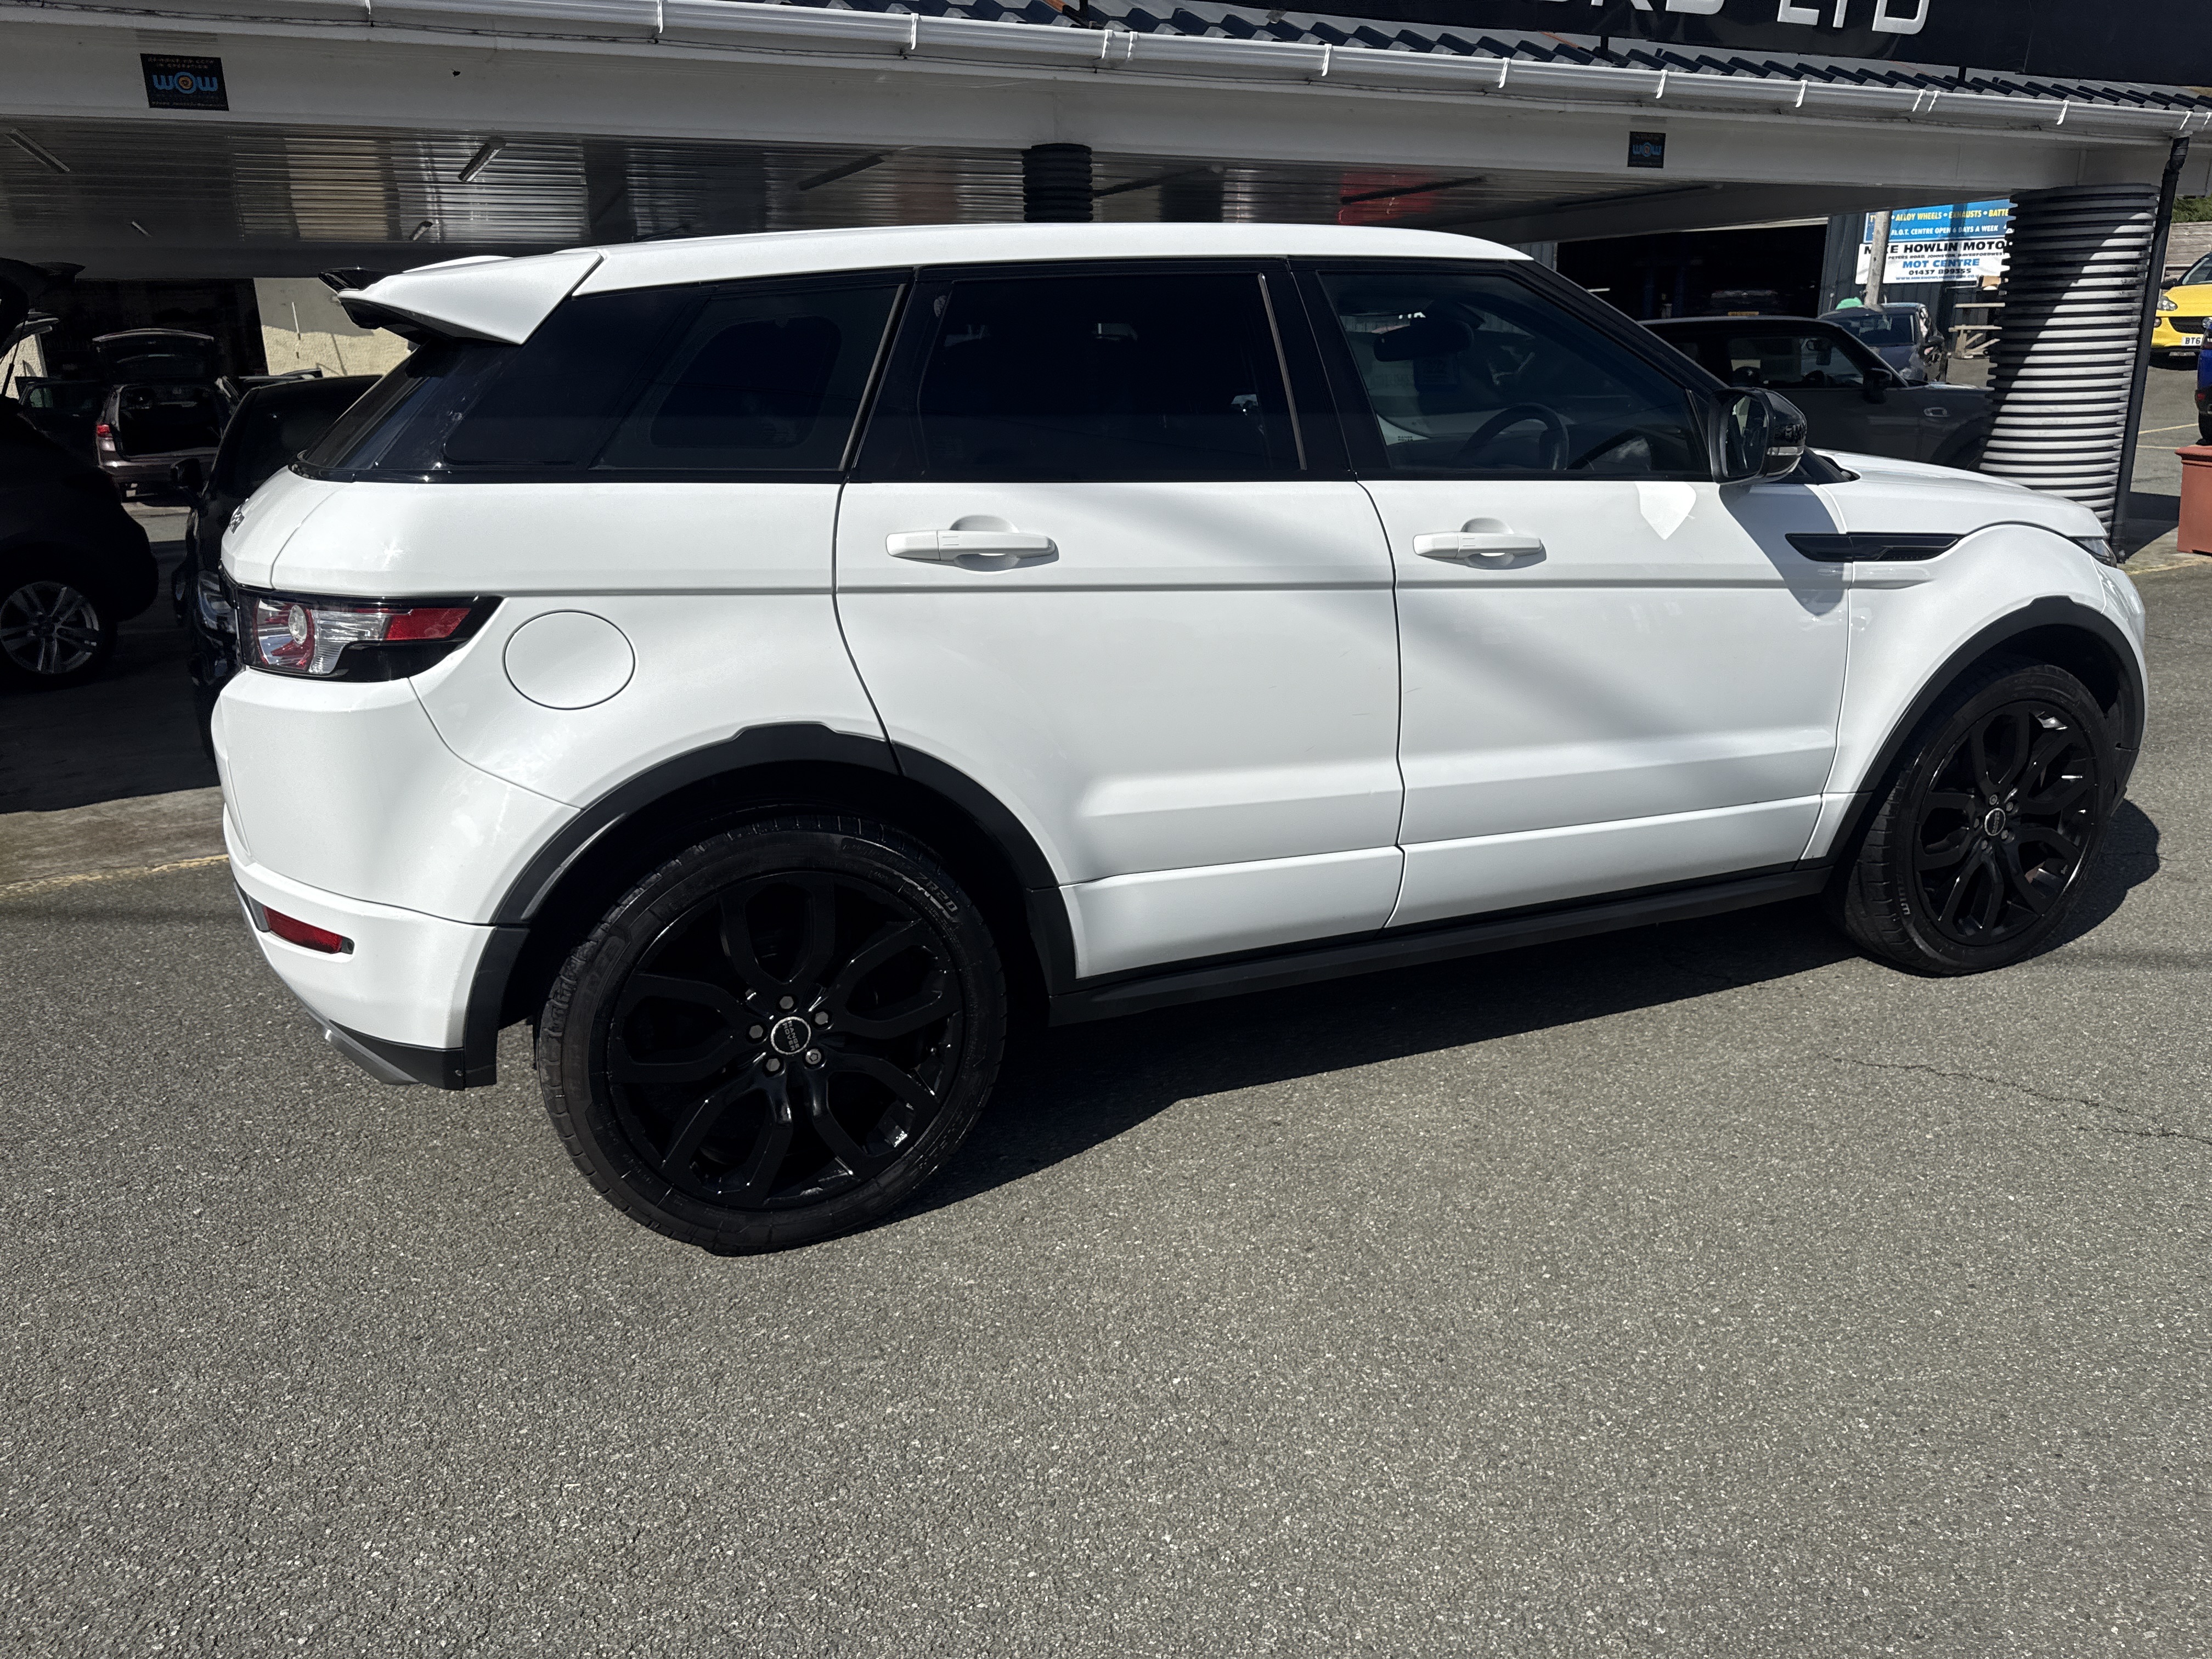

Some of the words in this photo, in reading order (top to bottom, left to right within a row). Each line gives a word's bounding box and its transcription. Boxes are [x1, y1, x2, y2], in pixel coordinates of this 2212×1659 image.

[1895, 213, 1916, 222] ALLOY
[1917, 211, 1942, 221] WHEELS
[1948, 210, 1982, 219] EXHAUSTS
[1904, 242, 1958, 253] HOWLIN
[1903, 260, 1929, 268] MOT
[1933, 258, 1980, 267] CENTRE
[782, 1022, 795, 1051] ROVER
[788, 1020, 800, 1048] RANGE
